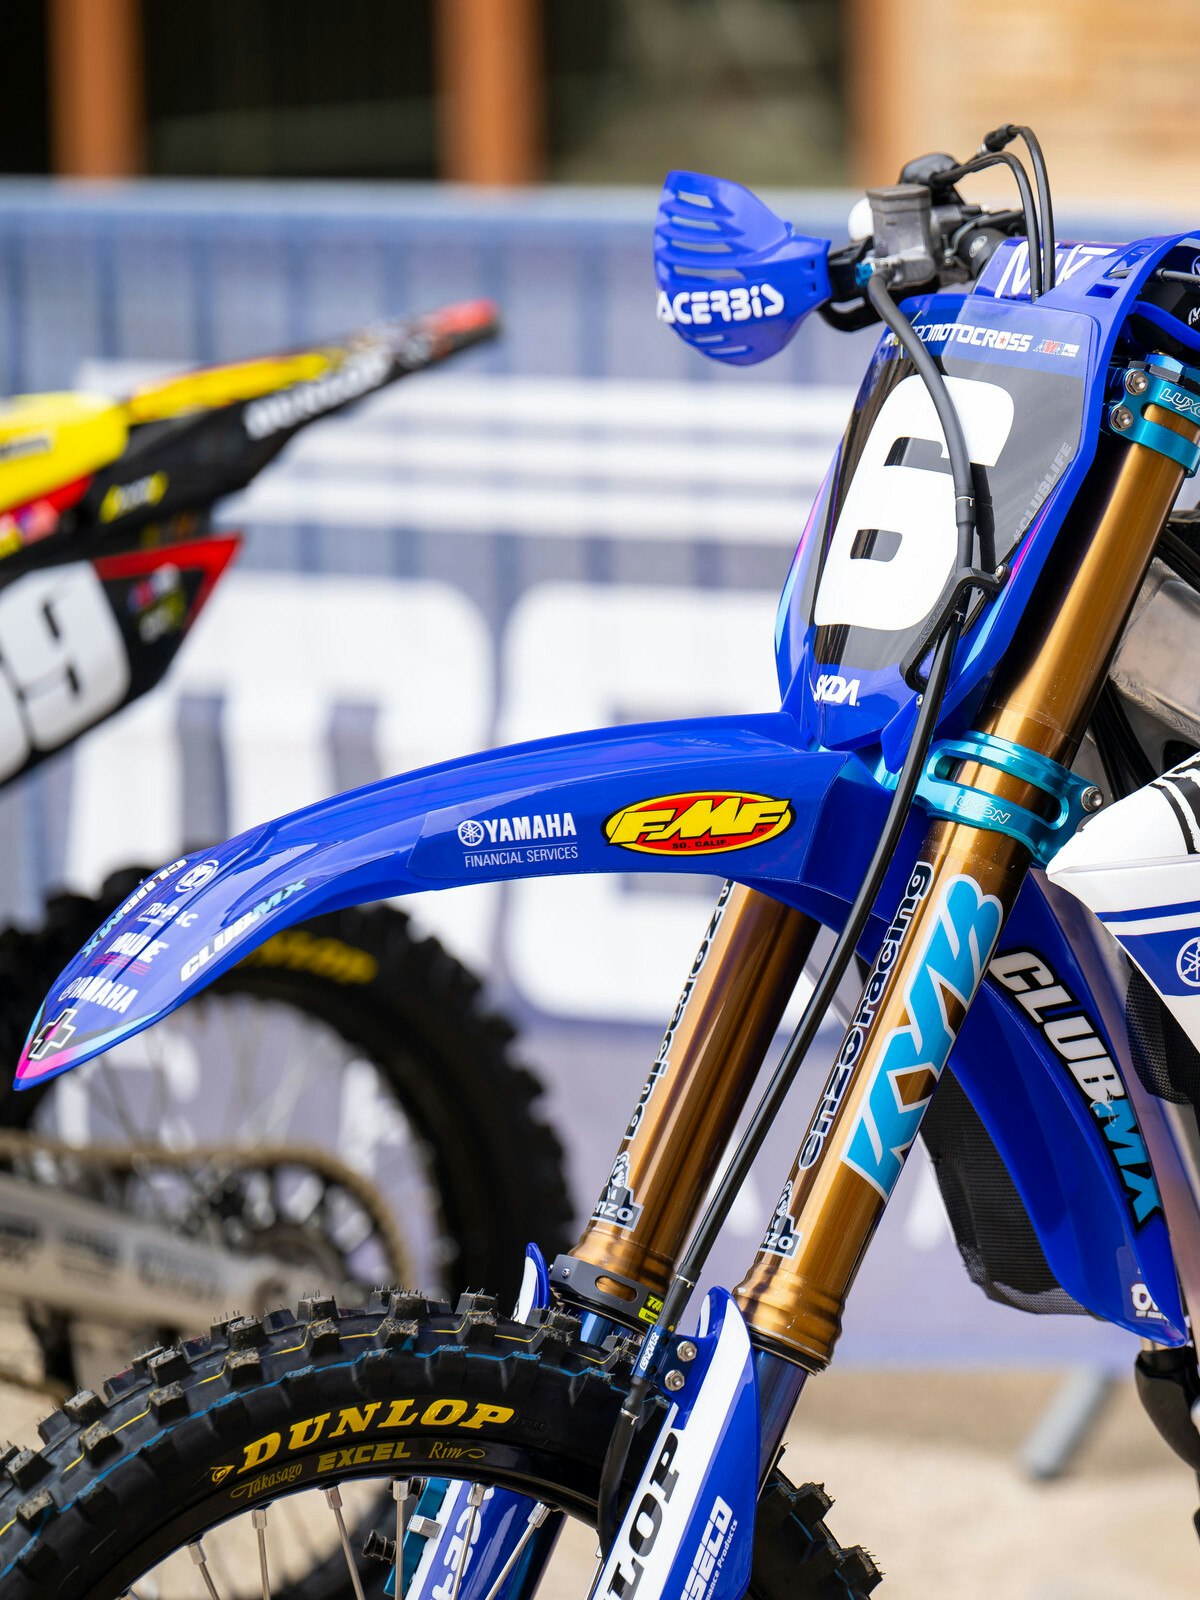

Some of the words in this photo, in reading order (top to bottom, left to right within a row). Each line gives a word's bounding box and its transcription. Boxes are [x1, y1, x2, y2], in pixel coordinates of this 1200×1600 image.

[814, 373, 1015, 631] 6
[813, 674, 861, 706] SKDA
[464, 850, 524, 868] FINANCIAL
[526, 846, 579, 863] SERVICES
[483, 812, 577, 843] YAMAHA
[607, 797, 793, 846] FMF
[180, 878, 309, 983] CLUBMX
[72, 975, 138, 1014] YAMAHA
[798, 861, 934, 1171] enzoracing
[839, 873, 1003, 1202] KYB
[988, 950, 1163, 1225] CLUBMX
[230, 1461, 303, 1499] Takasago
[316, 1441, 412, 1474] EXCEL
[428, 1441, 486, 1460] Rim
[237, 1398, 515, 1475] DUNLOP
[603, 1431, 680, 1600] LOP
[680, 1495, 733, 1600] SECO
[716, 1518, 739, 1569] Products
